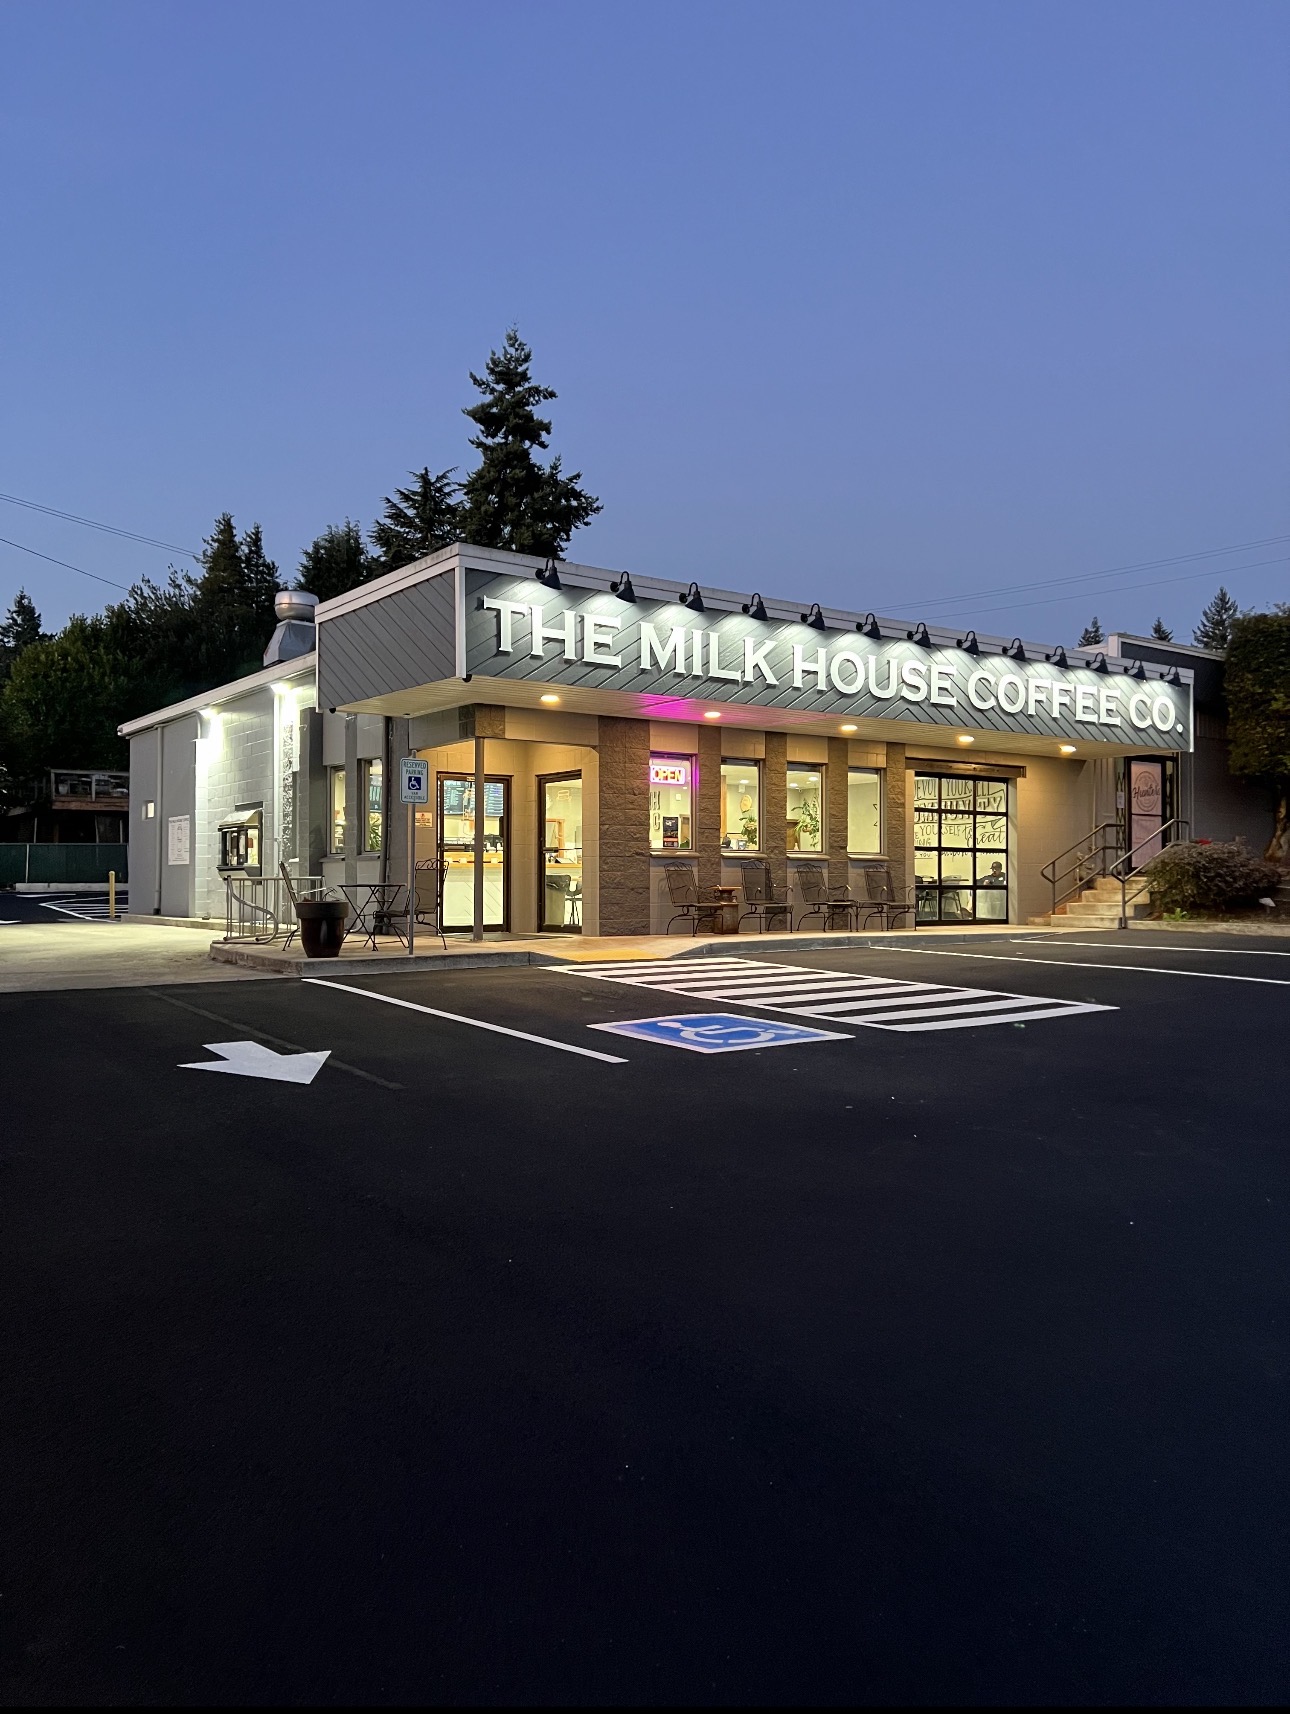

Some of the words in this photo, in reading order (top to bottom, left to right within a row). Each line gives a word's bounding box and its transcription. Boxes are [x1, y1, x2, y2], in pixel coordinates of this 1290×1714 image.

[483, 595, 622, 668] THE
[639, 621, 779, 687] MILK
[792, 644, 957, 708] HOUSE
[967, 670, 1122, 728] COFFEE
[1129, 693, 1184, 734] CO.
[403, 761, 427, 769] RESERVED
[654, 769, 682, 782] OPEN
[919, 824, 961, 836] YOUSELF
